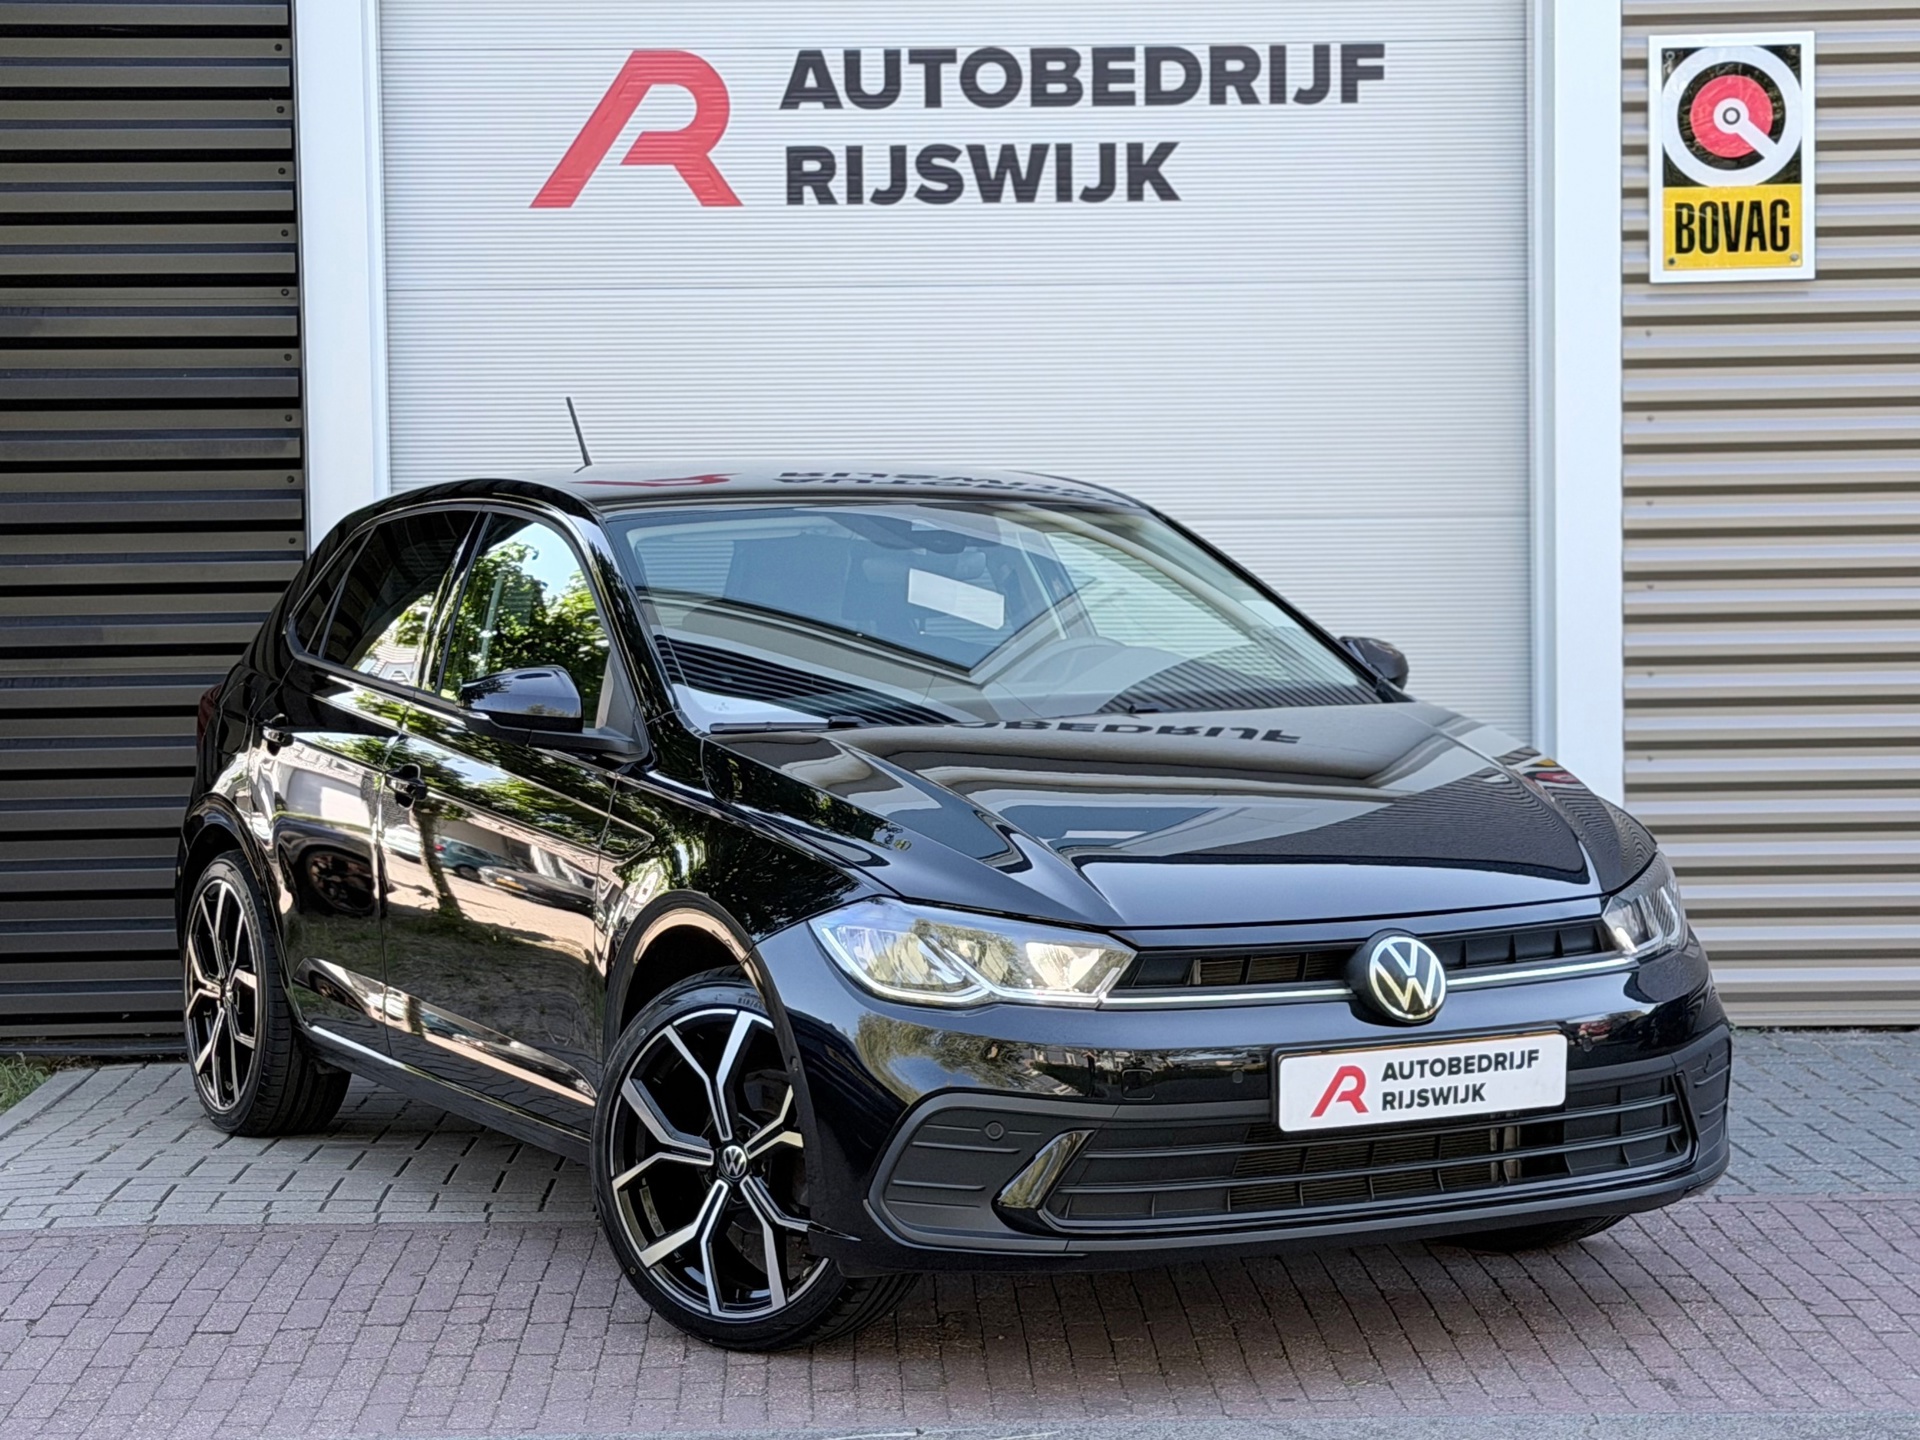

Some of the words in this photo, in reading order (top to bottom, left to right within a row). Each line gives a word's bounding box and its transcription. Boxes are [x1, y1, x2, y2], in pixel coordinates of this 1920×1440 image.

[780, 43, 1385, 110] AUTOBEDRIJF
[786, 141, 1180, 206] RIJSWIJK
[1675, 198, 1790, 254] BOVAG
[1381, 1049, 1540, 1082] AUTOBEDRIJF
[1382, 1083, 1486, 1111] RIJSWIJK
